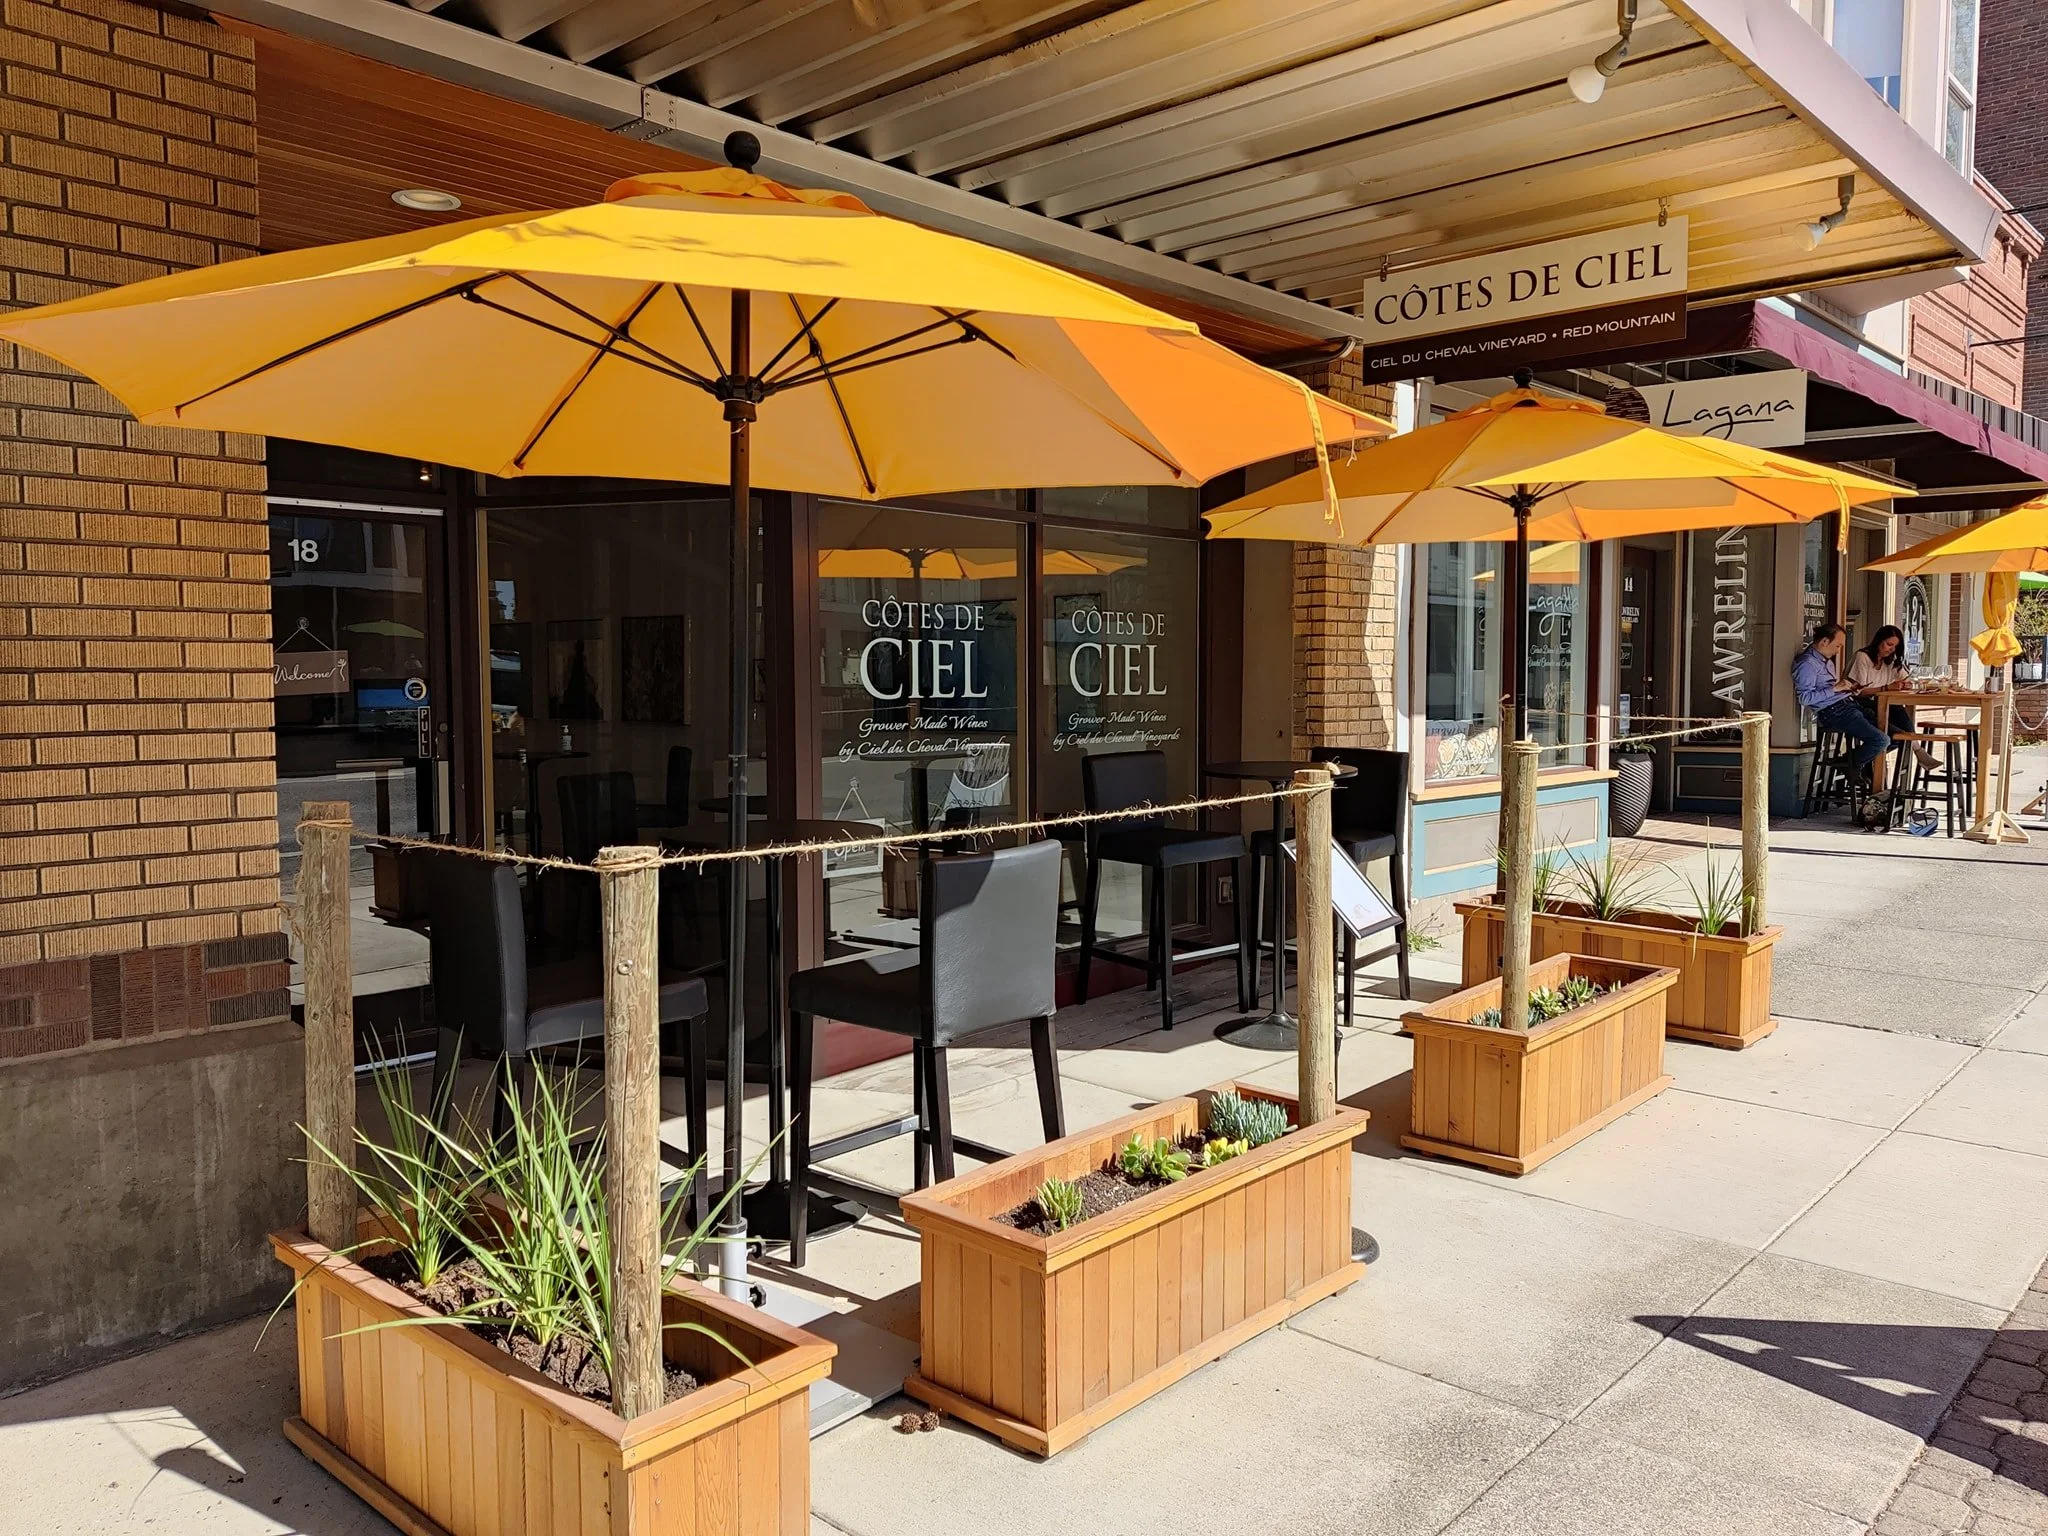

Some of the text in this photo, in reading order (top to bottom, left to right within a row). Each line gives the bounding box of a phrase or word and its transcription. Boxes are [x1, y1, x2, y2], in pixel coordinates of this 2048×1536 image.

[1375, 243, 1672, 325] CÔTES DE CIEL
[1370, 311, 1676, 369] CIEL DU CHEVAL VINEYARD RED MOUNTAIN
[1661, 389, 1795, 441] Lagana
[287, 538, 319, 563] 18
[1624, 576, 1634, 592] 14
[862, 595, 985, 631] CÔTES DE
[1071, 605, 1165, 636] CÔTES DE
[273, 664, 337, 685] Welcome
[860, 637, 988, 700] CIEL
[1069, 642, 1168, 697] CIEL
[420, 709, 429, 756] PULL
[859, 715, 989, 738] Grower Made Wines
[1068, 709, 1168, 730] Grower Made Wines
[838, 741, 855, 763] by
[857, 739, 889, 756] Ciel
[888, 738, 905, 755] du
[906, 736, 951, 754] Cheval
[1053, 728, 1181, 751] by Ciel du Cheval Vineyards
